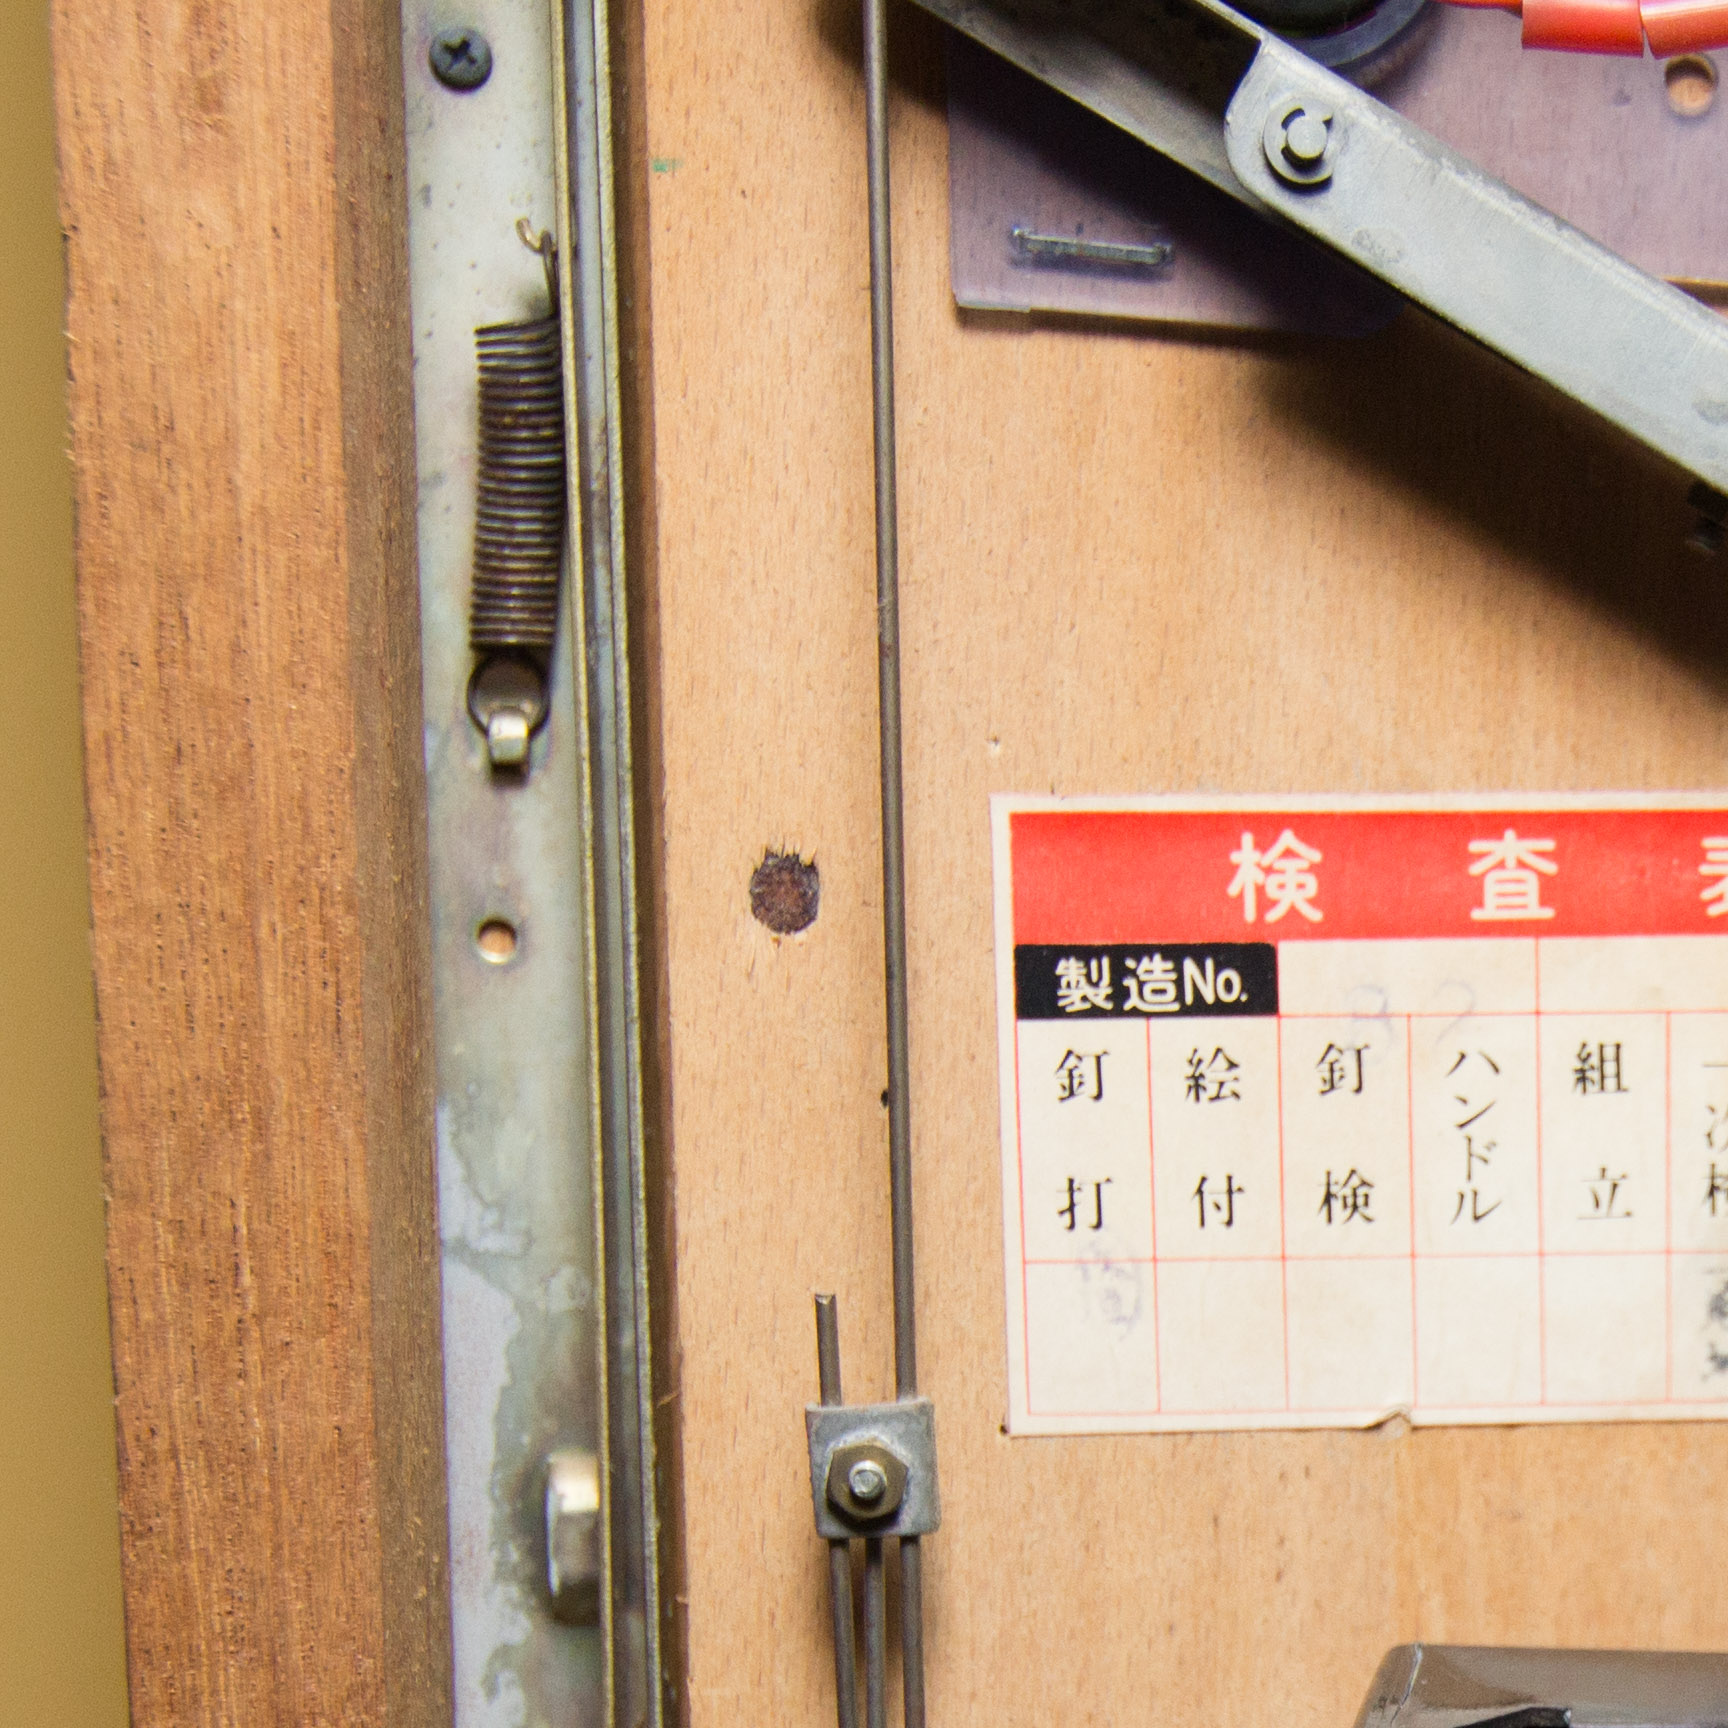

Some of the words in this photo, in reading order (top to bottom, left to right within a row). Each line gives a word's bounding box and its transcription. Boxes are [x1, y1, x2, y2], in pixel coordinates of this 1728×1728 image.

[1055, 1047, 1114, 1231] 釘打
[1184, 1046, 1246, 1229] 絵付
[1314, 1041, 1376, 1226] 釘検
[1445, 1049, 1502, 1226] ハンドル
[1572, 1040, 1634, 1221] 組立
